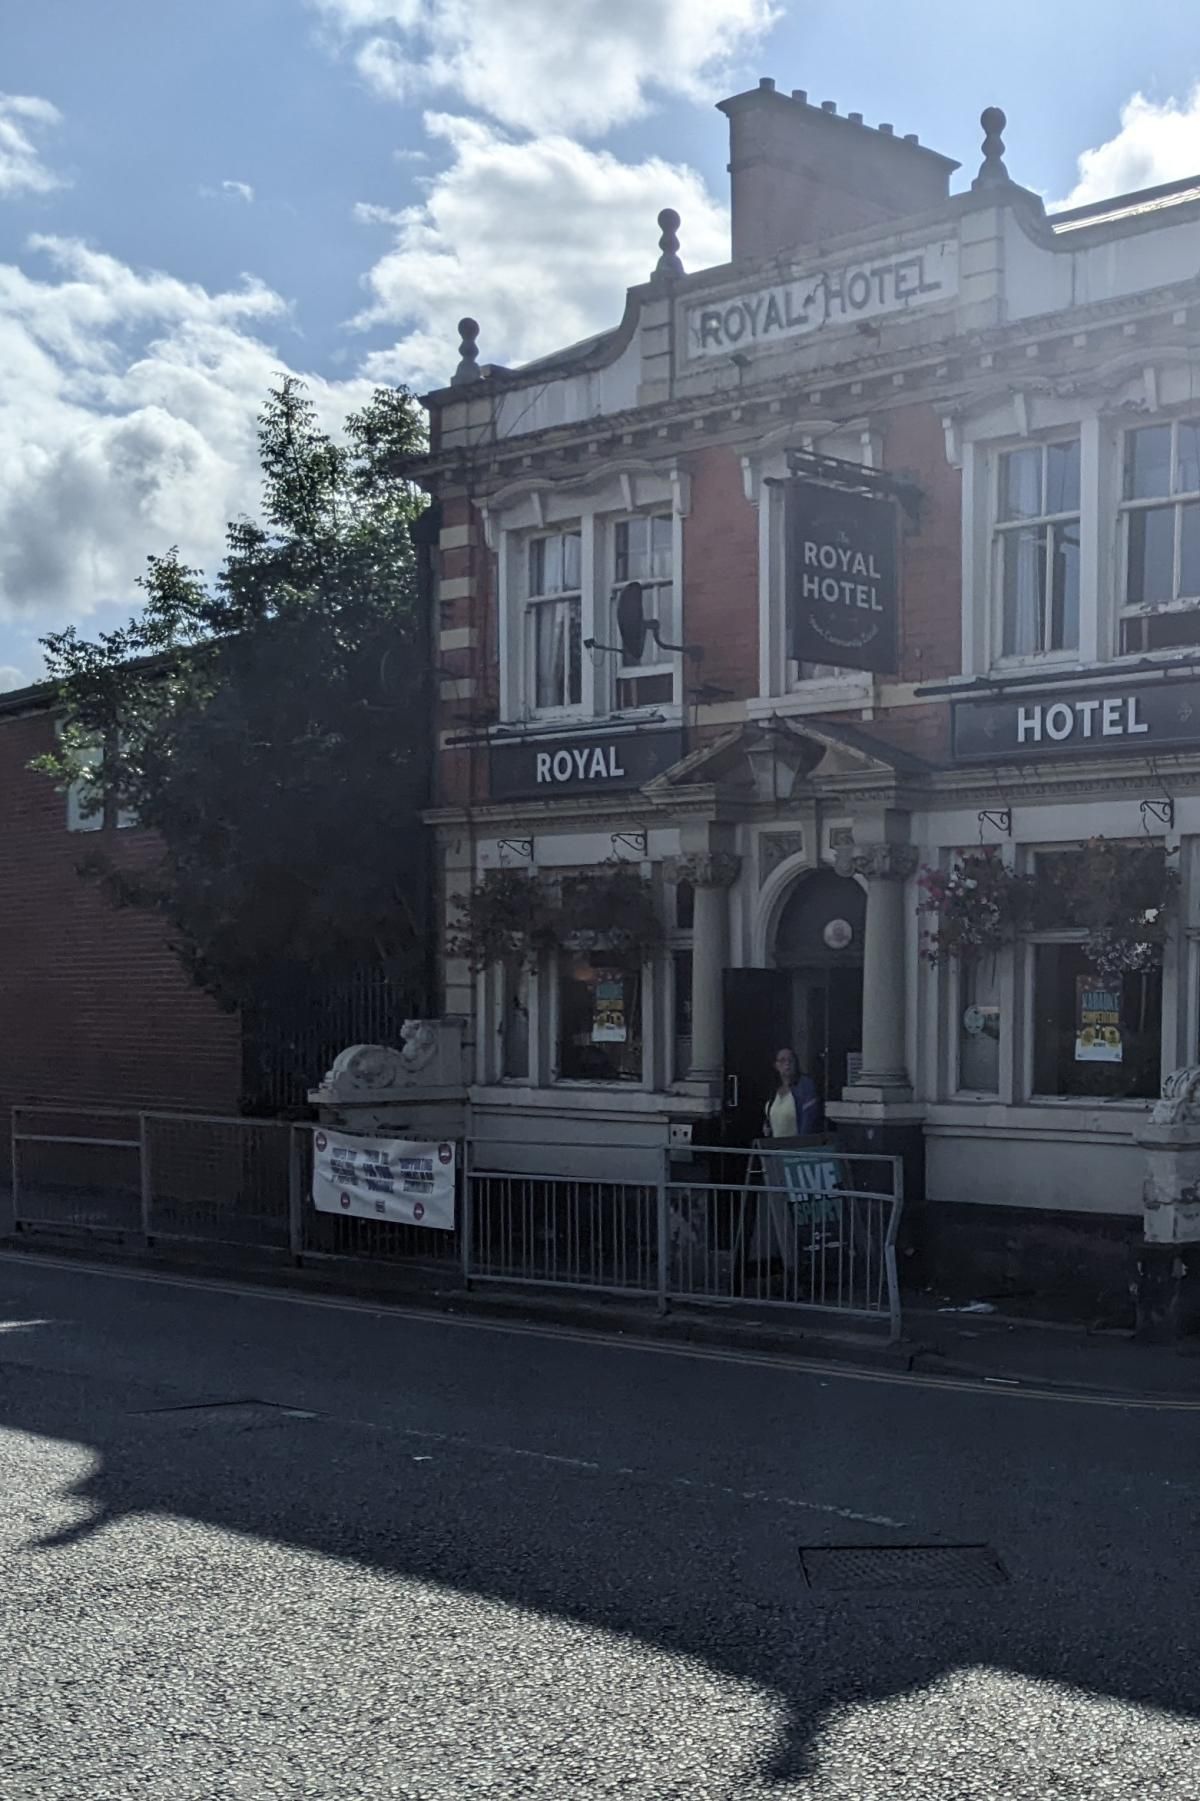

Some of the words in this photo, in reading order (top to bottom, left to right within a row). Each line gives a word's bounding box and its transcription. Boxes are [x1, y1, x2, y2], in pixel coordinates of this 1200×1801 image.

[700, 290, 809, 348] ROYAL
[823, 255, 942, 318] HOTEL
[803, 541, 881, 579] ROYAL
[802, 573, 883, 612] HOTEL
[1017, 697, 1149, 742] HOTEL
[536, 746, 625, 783] ROYAL
[784, 1161, 842, 1202] LIVE
